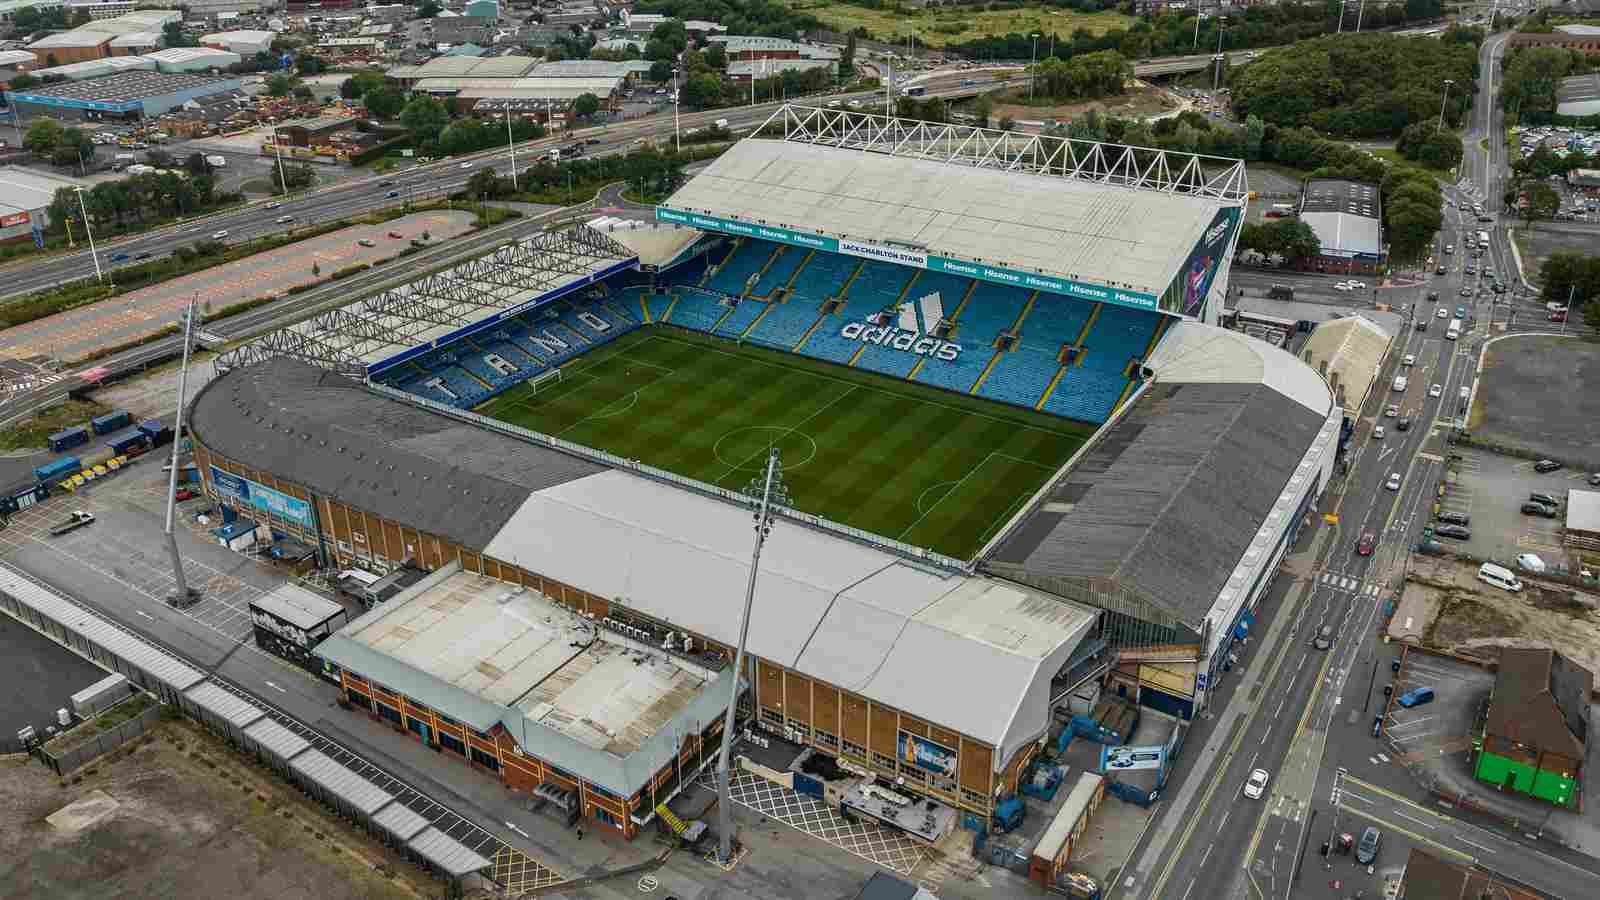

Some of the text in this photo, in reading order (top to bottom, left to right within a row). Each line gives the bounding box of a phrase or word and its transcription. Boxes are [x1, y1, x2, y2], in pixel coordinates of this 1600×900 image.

[900, 253, 925, 264] STAND
[943, 261, 977, 273] Hisense
[984, 269, 1020, 282] Hisense
[1026, 276, 1063, 290] Hisense
[1070, 284, 1108, 298] Hisense
[1115, 292, 1154, 306] Hisense
[841, 321, 962, 361] adidas
